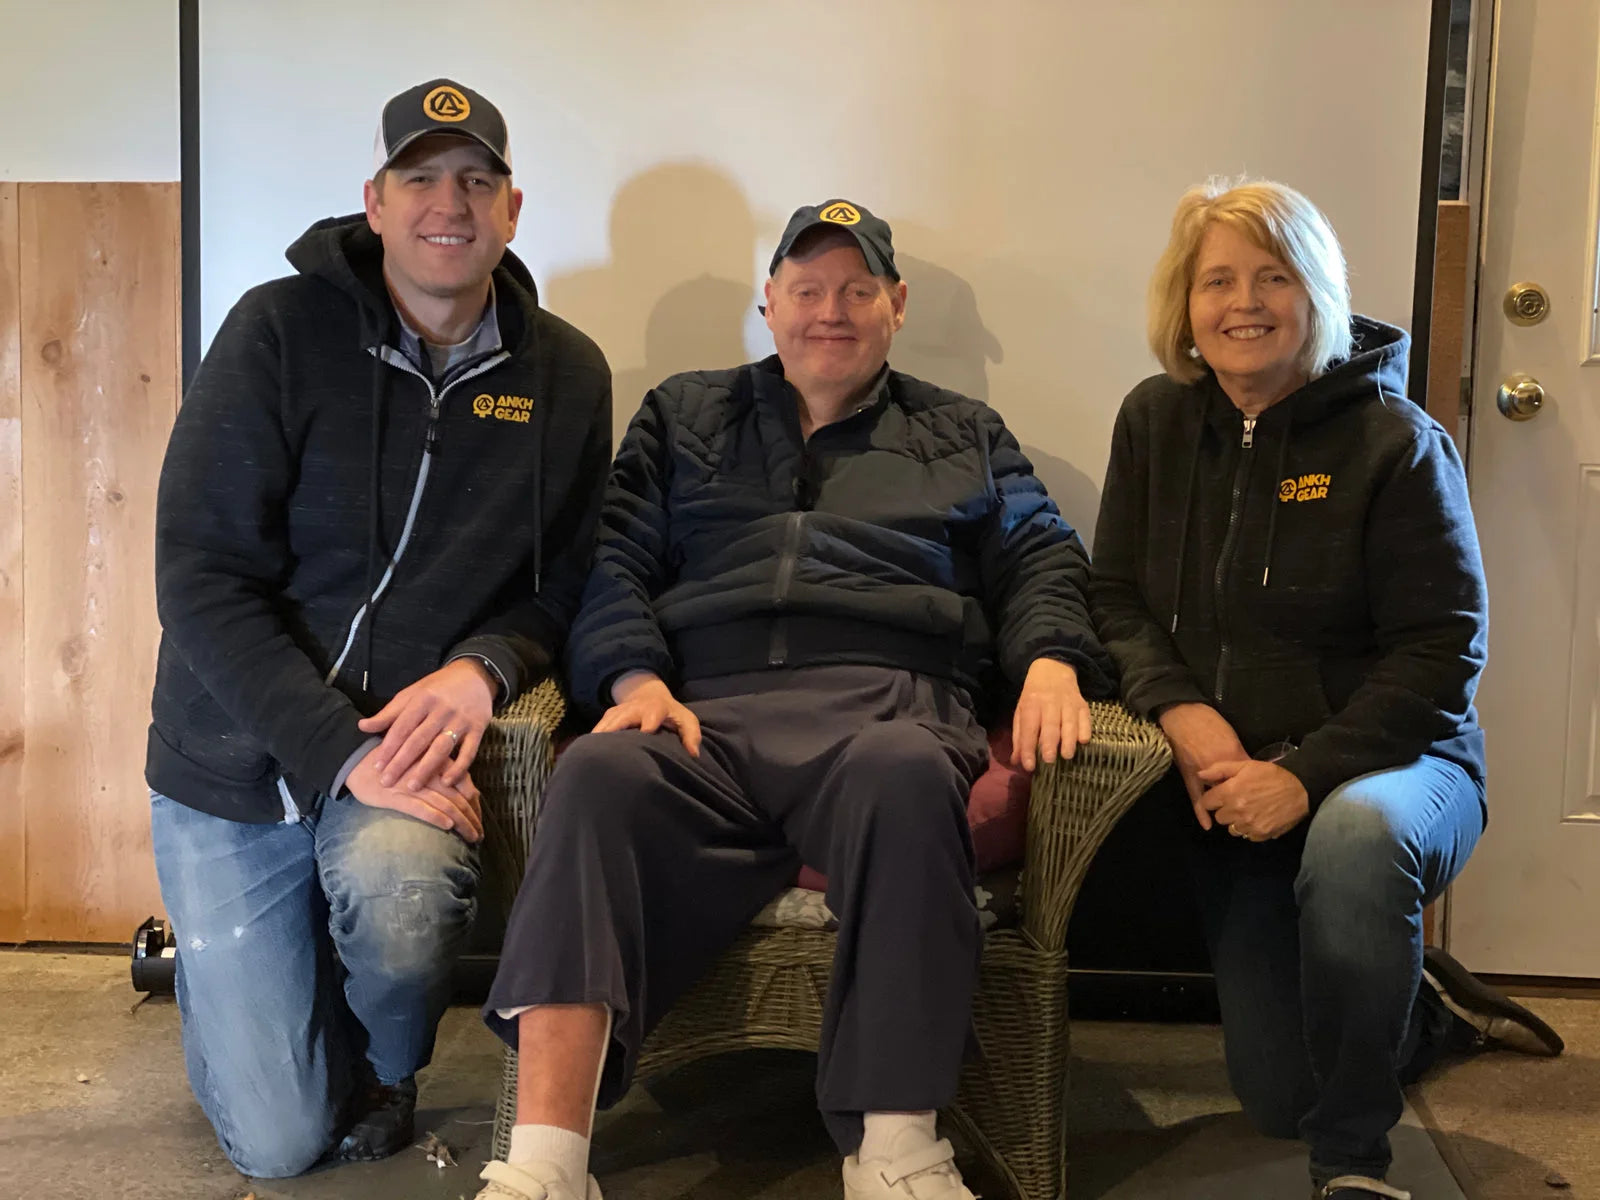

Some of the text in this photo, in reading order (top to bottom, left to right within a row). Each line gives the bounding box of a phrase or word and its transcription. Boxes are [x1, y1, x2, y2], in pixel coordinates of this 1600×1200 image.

[497, 395, 534, 410] ANKH
[494, 408, 531, 423] GEAR
[1298, 474, 1331, 489] ANKH
[1296, 486, 1328, 502] GEAR
